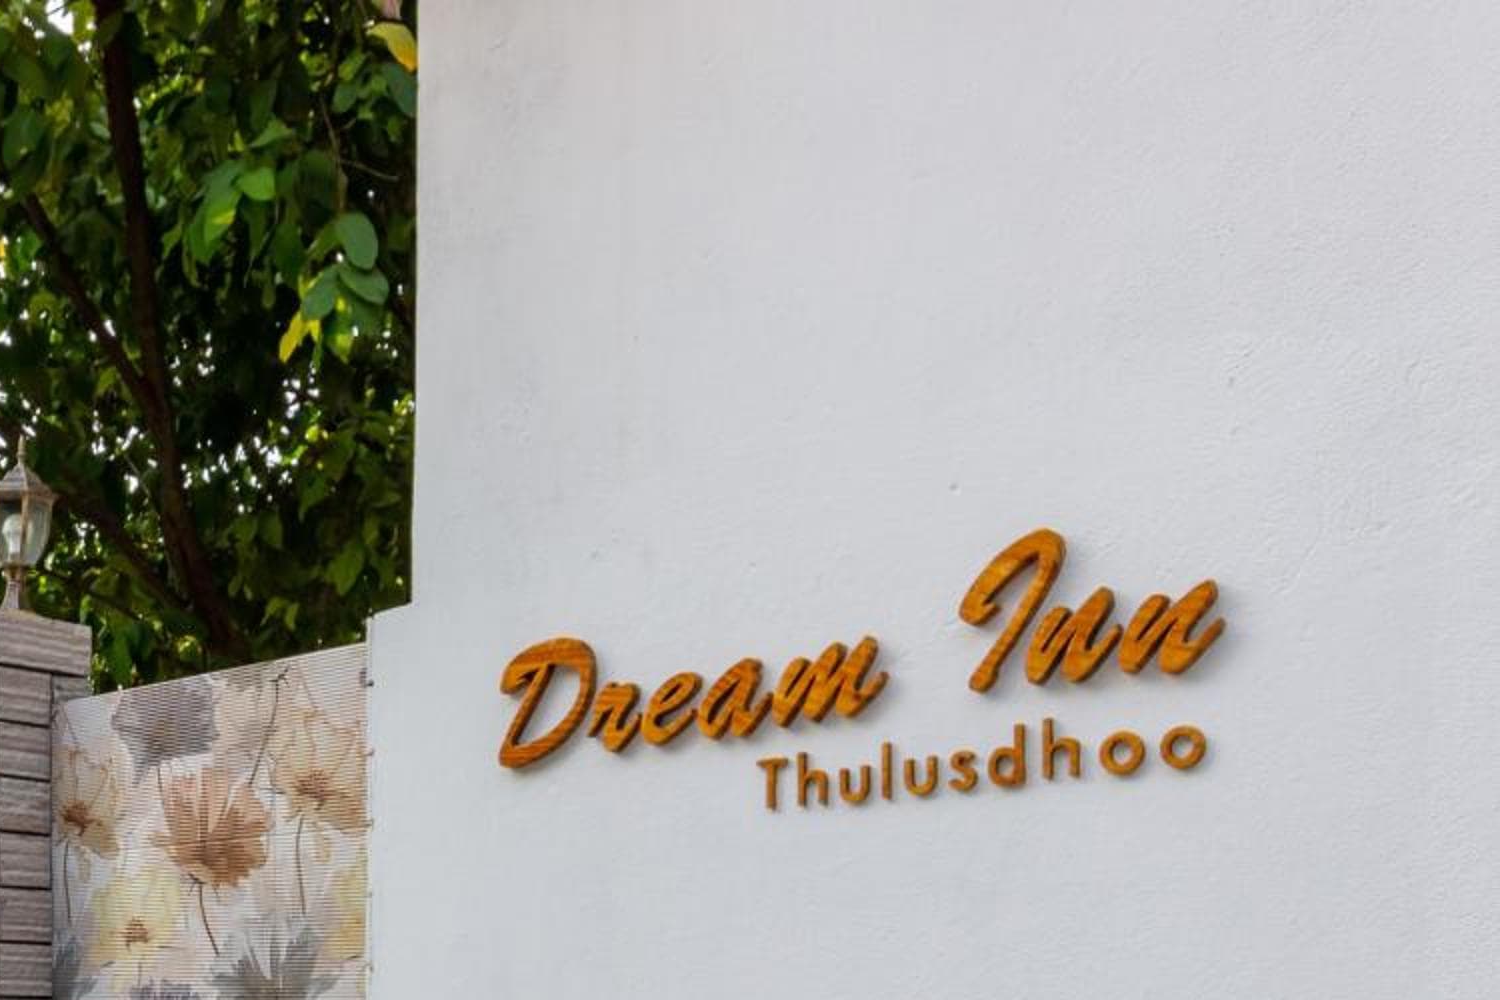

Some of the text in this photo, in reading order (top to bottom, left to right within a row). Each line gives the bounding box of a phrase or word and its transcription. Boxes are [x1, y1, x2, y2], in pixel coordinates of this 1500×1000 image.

[499, 527, 1226, 770] Dream Inn
[756, 718, 1208, 812] Thulusdhoo
